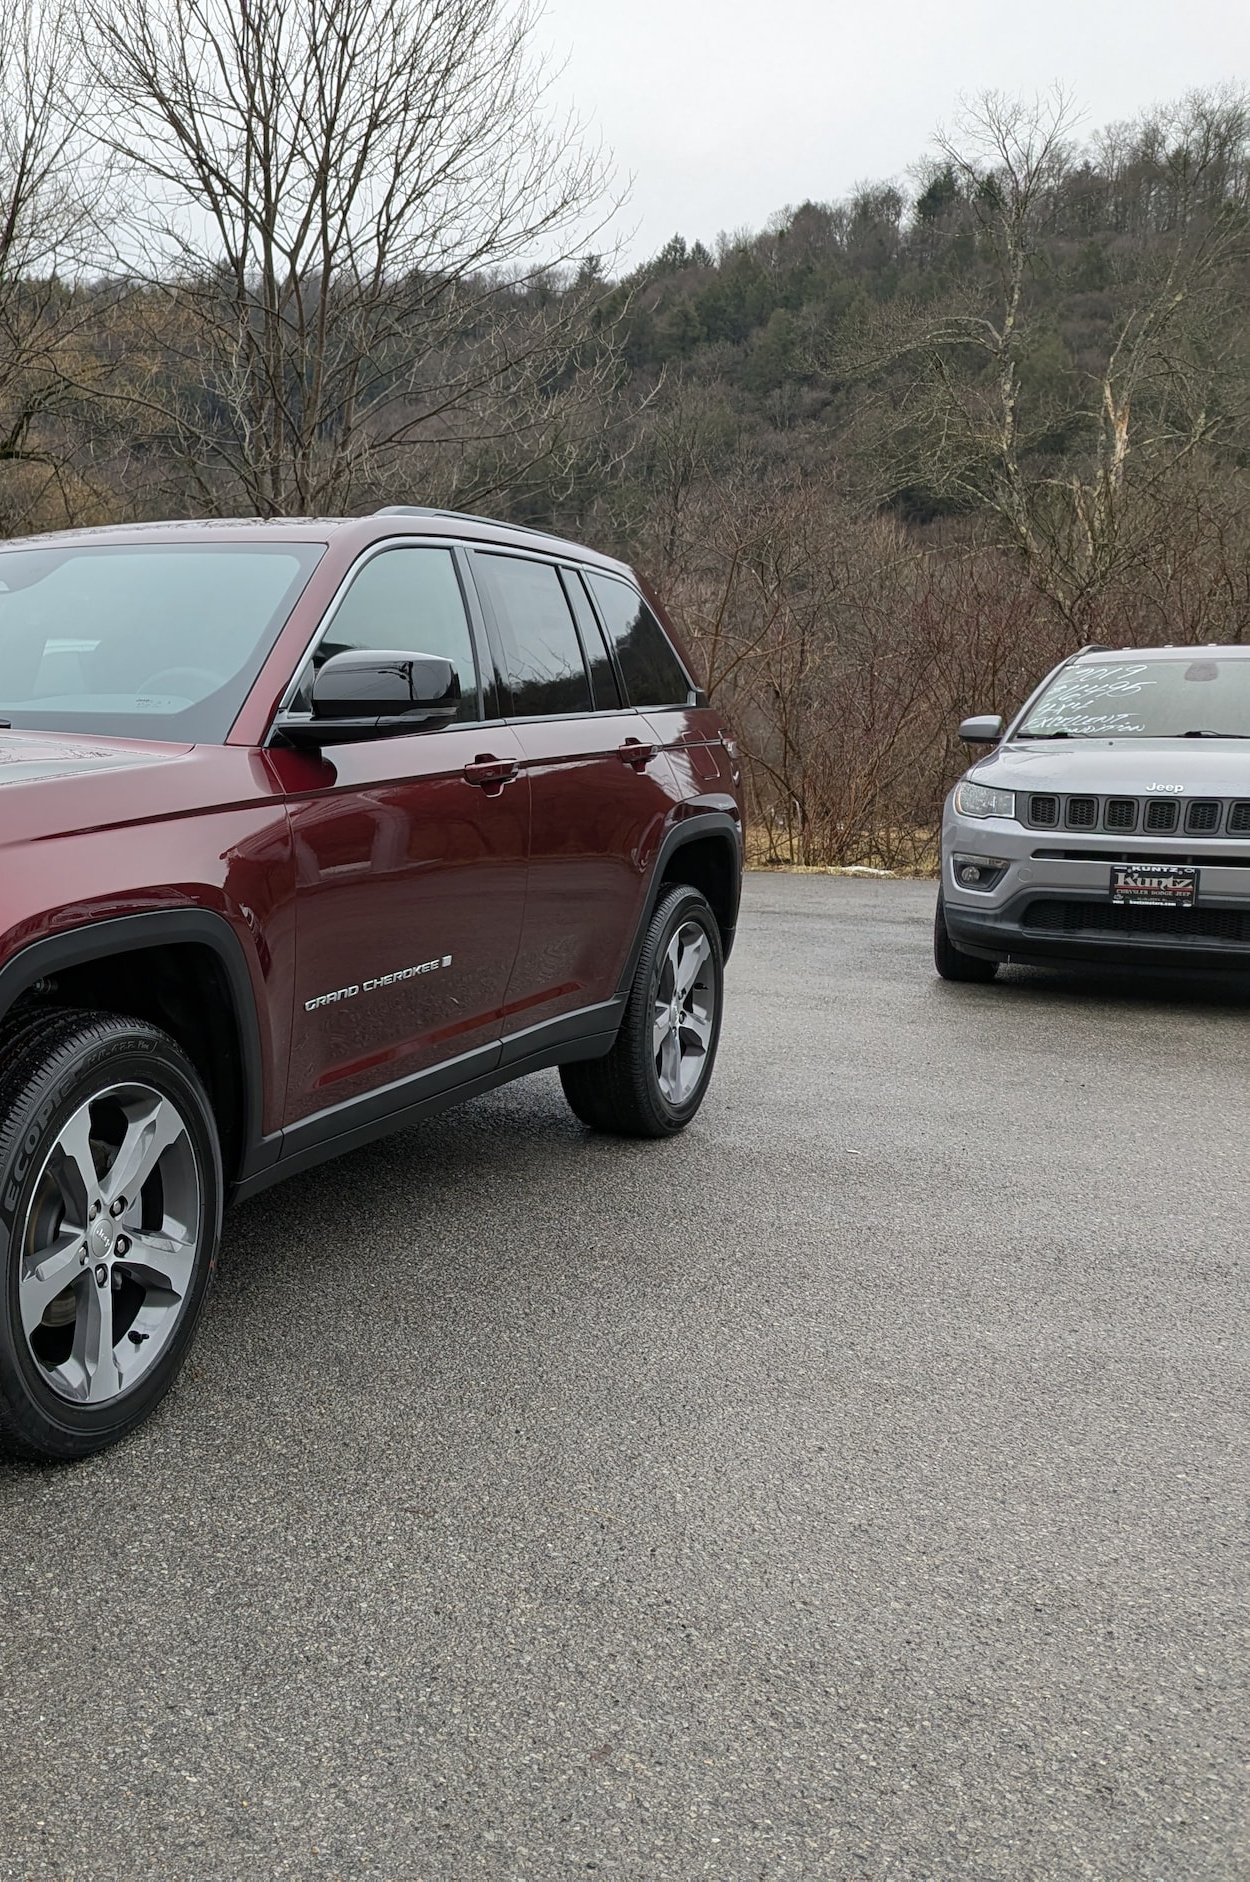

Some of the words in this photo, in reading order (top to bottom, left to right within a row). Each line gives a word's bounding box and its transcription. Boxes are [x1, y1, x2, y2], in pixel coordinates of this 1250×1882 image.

[1146, 782, 1184, 794] Jeep
[1114, 872, 1193, 890] Kuntz
[304, 985, 360, 1012] GRAND
[362, 959, 440, 993] CHEROKEE
